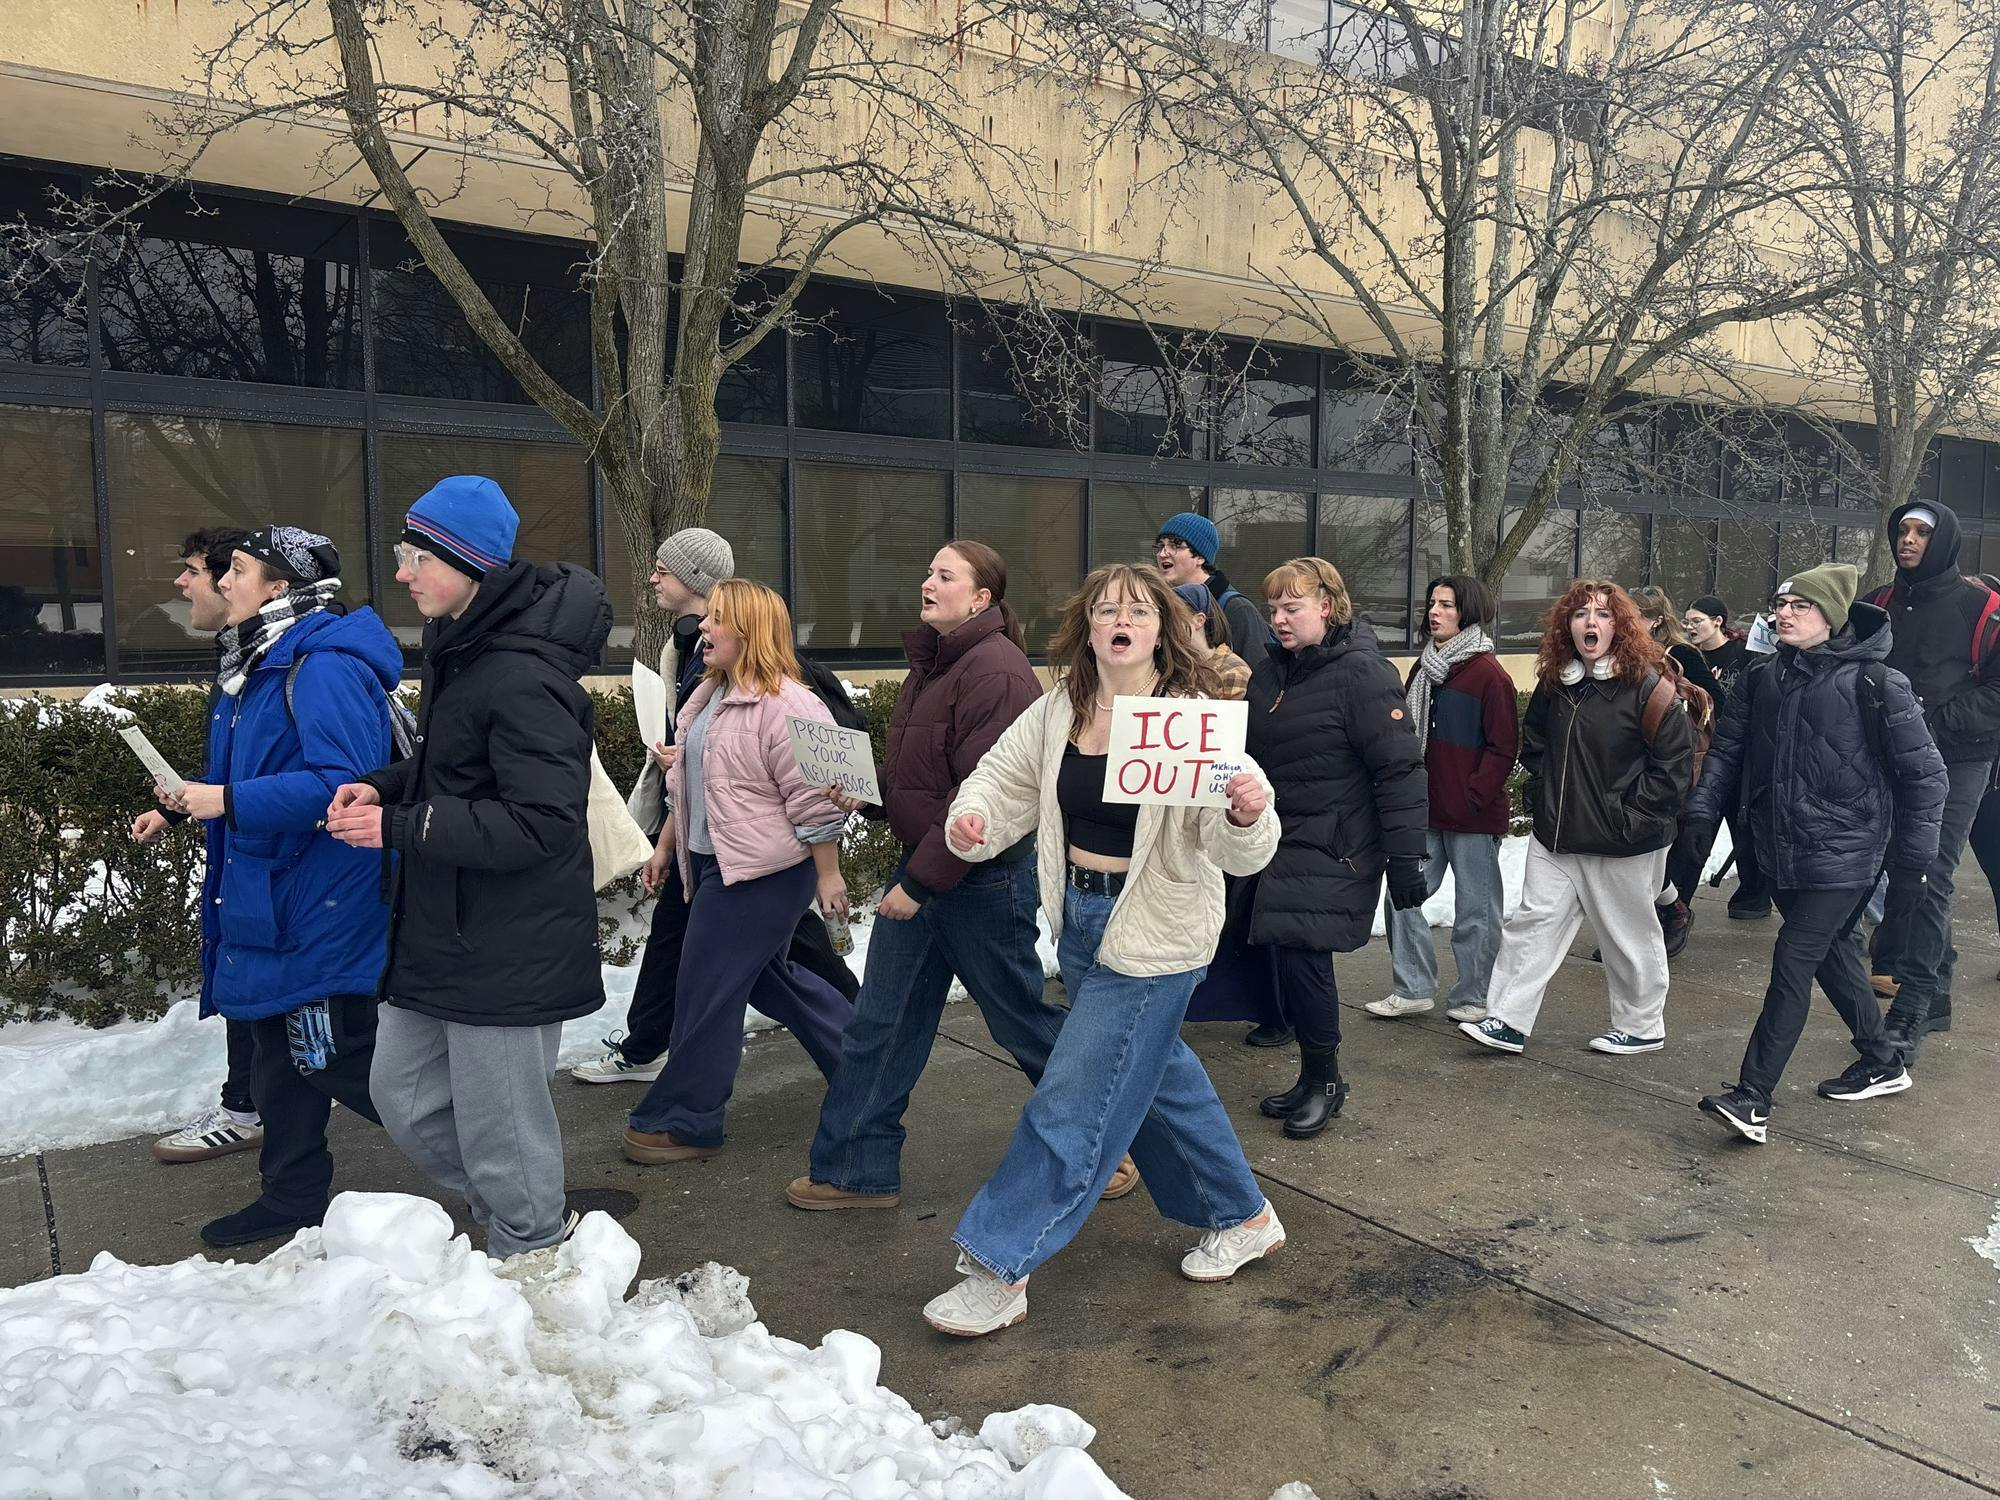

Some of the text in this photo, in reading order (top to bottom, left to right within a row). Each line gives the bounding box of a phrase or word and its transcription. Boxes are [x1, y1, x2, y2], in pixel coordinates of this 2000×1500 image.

[1753, 622, 1779, 647] IC
[1130, 711, 1222, 753] ICE
[808, 744, 854, 767] YOUR
[1118, 758, 1215, 799] OUT
